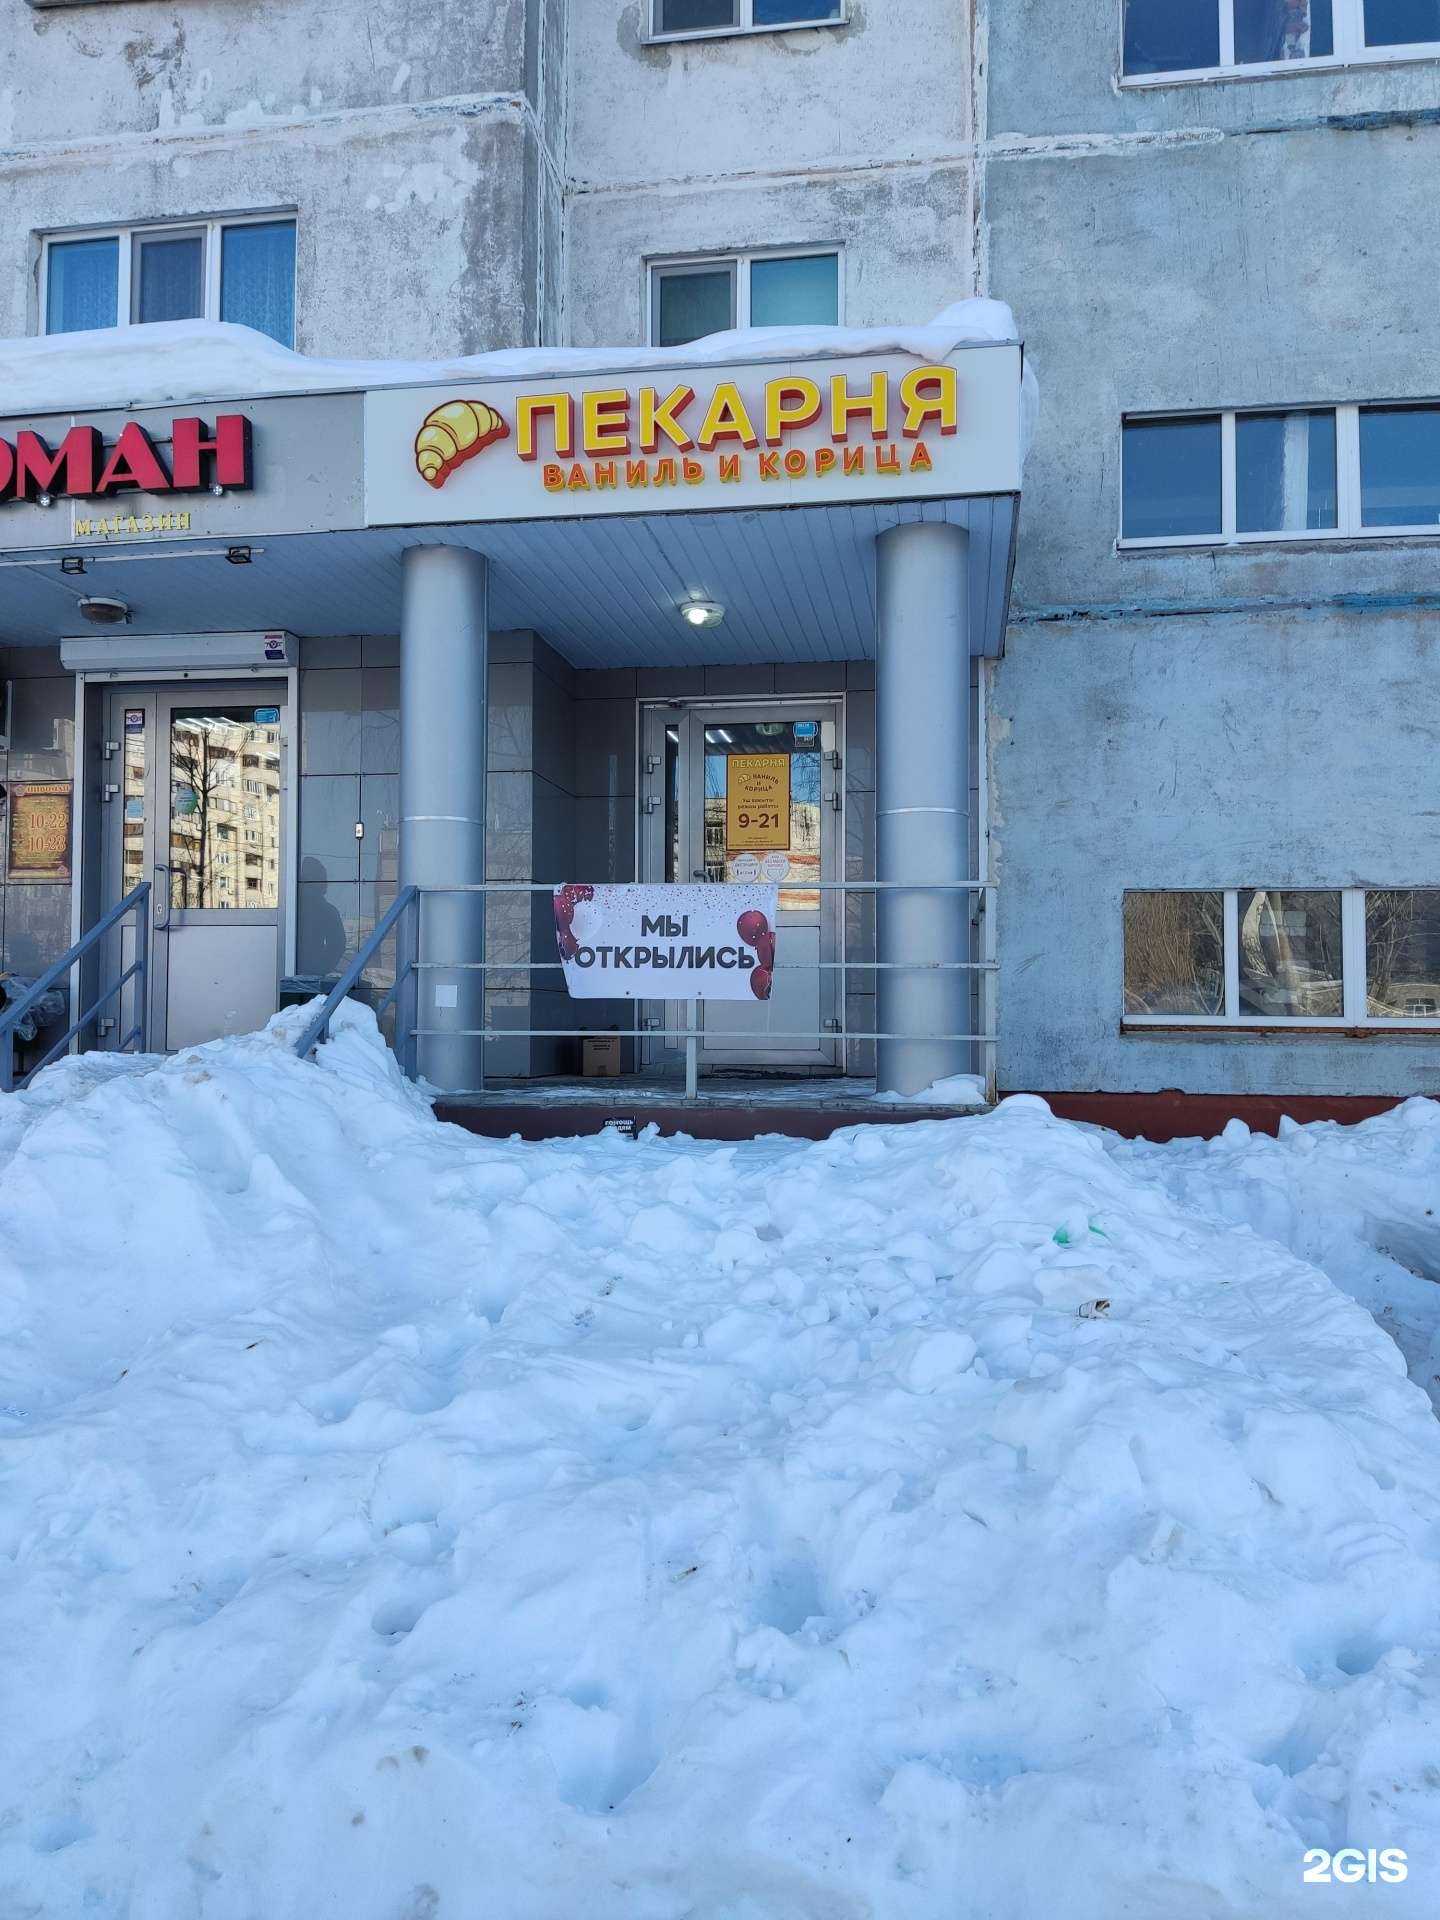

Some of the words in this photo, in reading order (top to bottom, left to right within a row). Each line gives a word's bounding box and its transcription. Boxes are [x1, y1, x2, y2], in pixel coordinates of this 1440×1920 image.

[515, 365, 958, 461] ПЕКАРНЯ
[543, 457, 704, 492] ВАНИЛЬ
[719, 452, 741, 483] И
[758, 441, 933, 481] КОРИЦА
[75, 512, 191, 537] МАГАЗИН
[732, 758, 785, 768] ПЕКАРНЯ
[738, 813, 779, 828] 9-21
[641, 915, 689, 937] МЫ
[574, 946, 756, 969] ОТКРЫЛИСЬ
